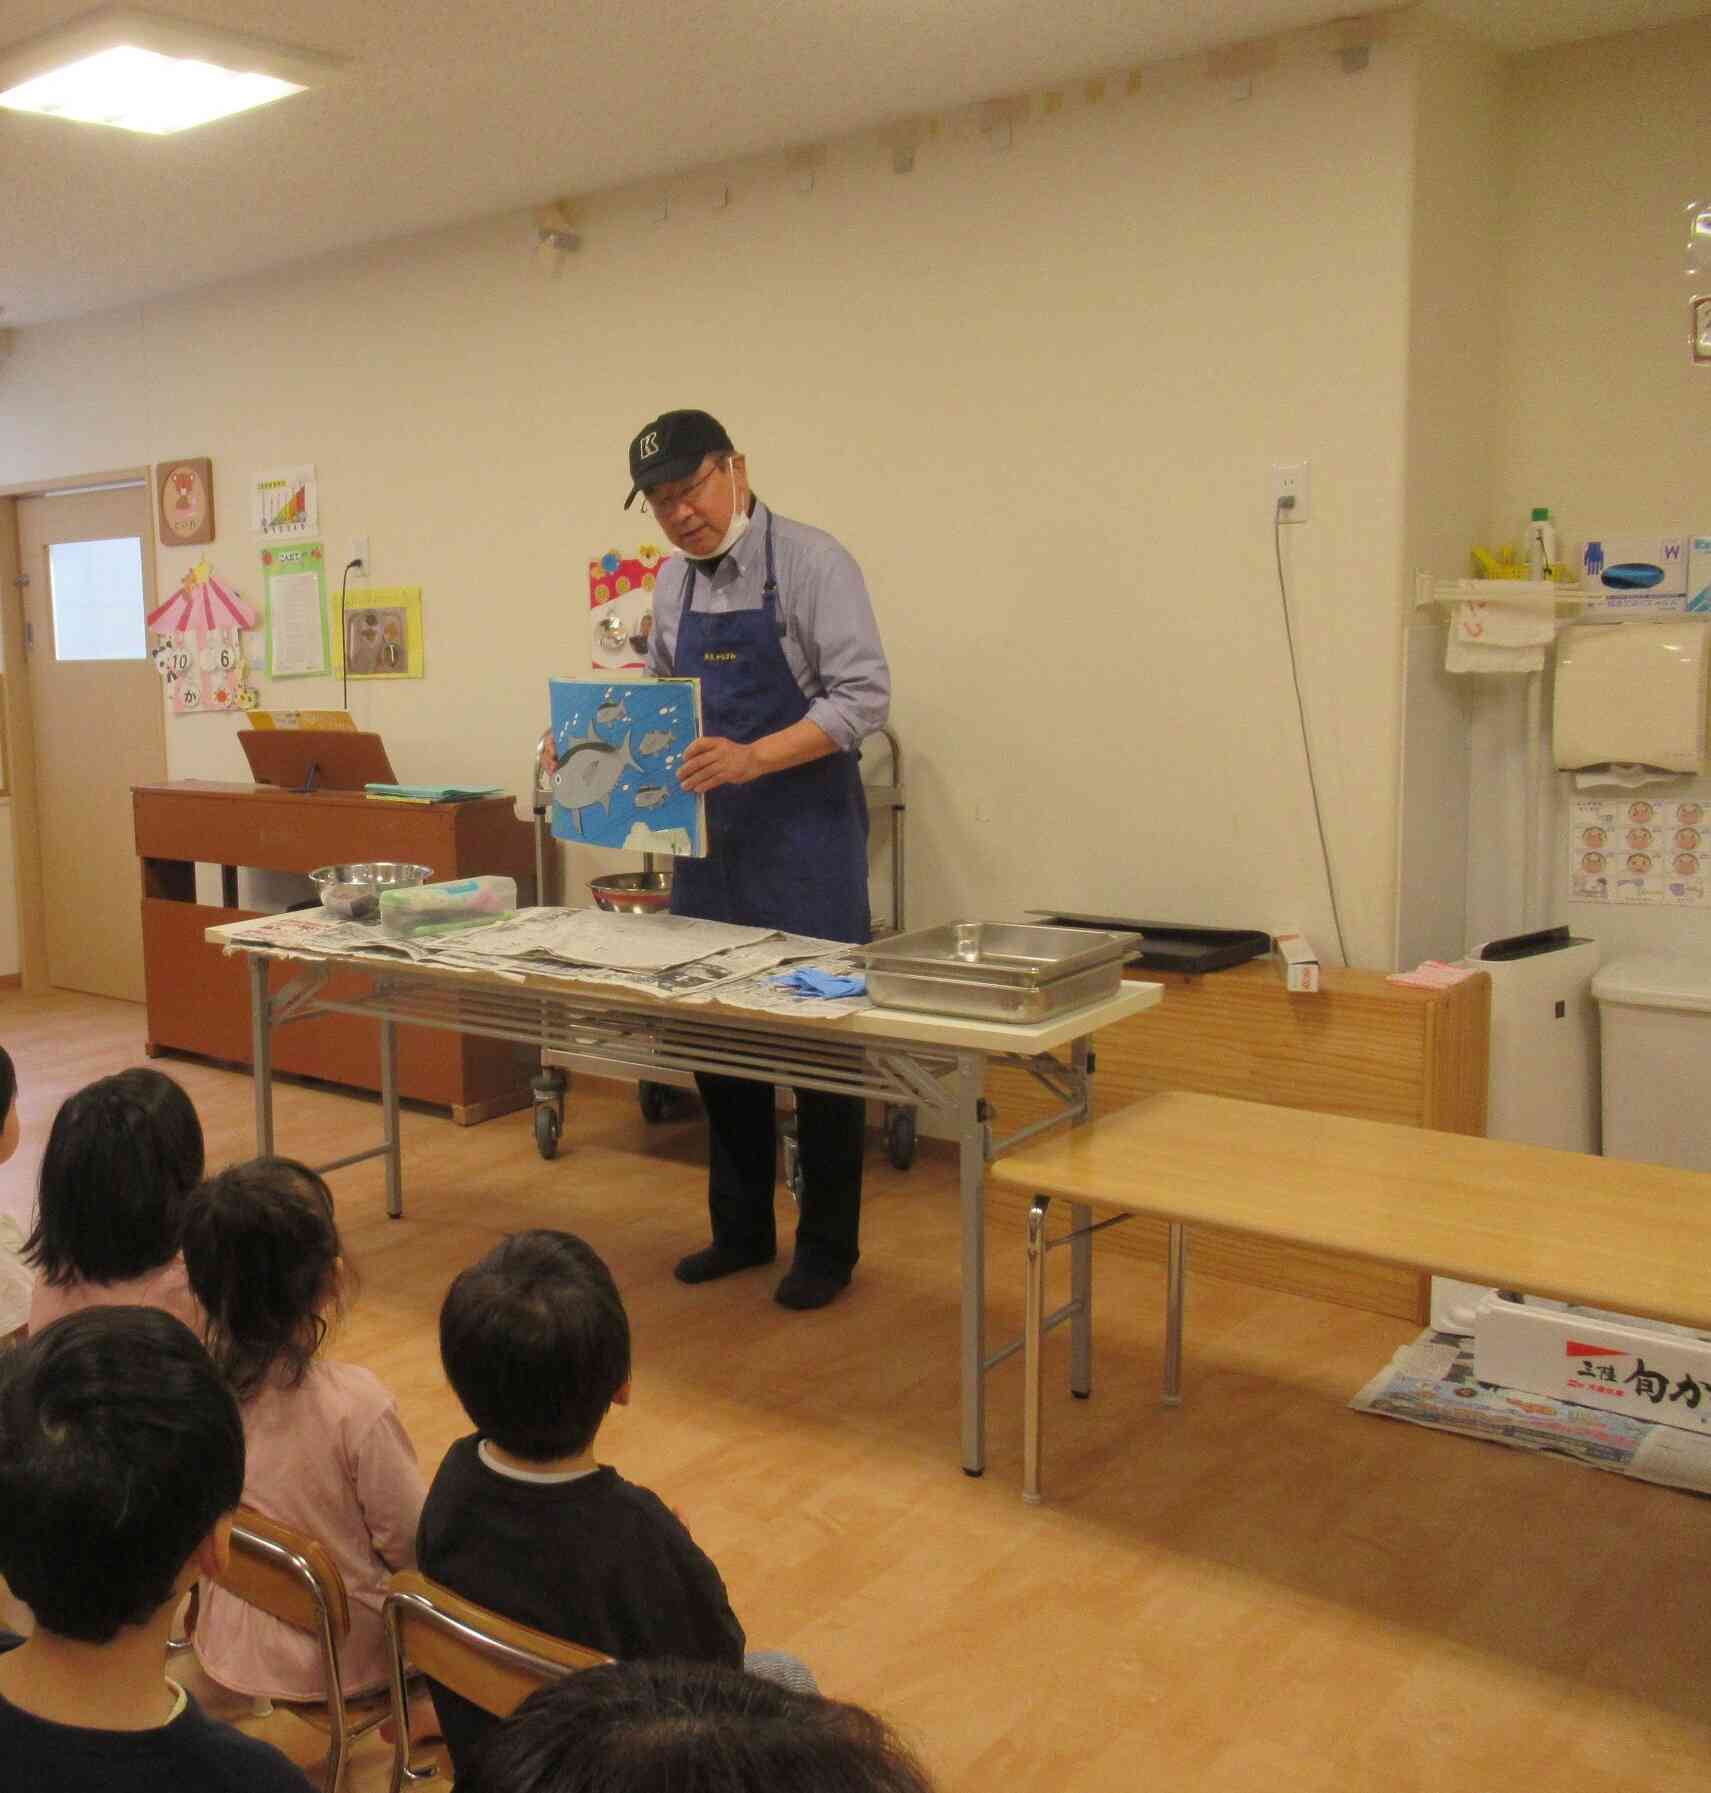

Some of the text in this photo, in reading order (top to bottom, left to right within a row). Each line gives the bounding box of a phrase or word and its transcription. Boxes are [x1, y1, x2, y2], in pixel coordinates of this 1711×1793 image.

[640, 432, 660, 460] K
[1664, 544, 1680, 559] W
[172, 654, 188, 669] 10
[220, 649, 229, 668] 6
[1576, 1359, 1617, 1383] 三陸
